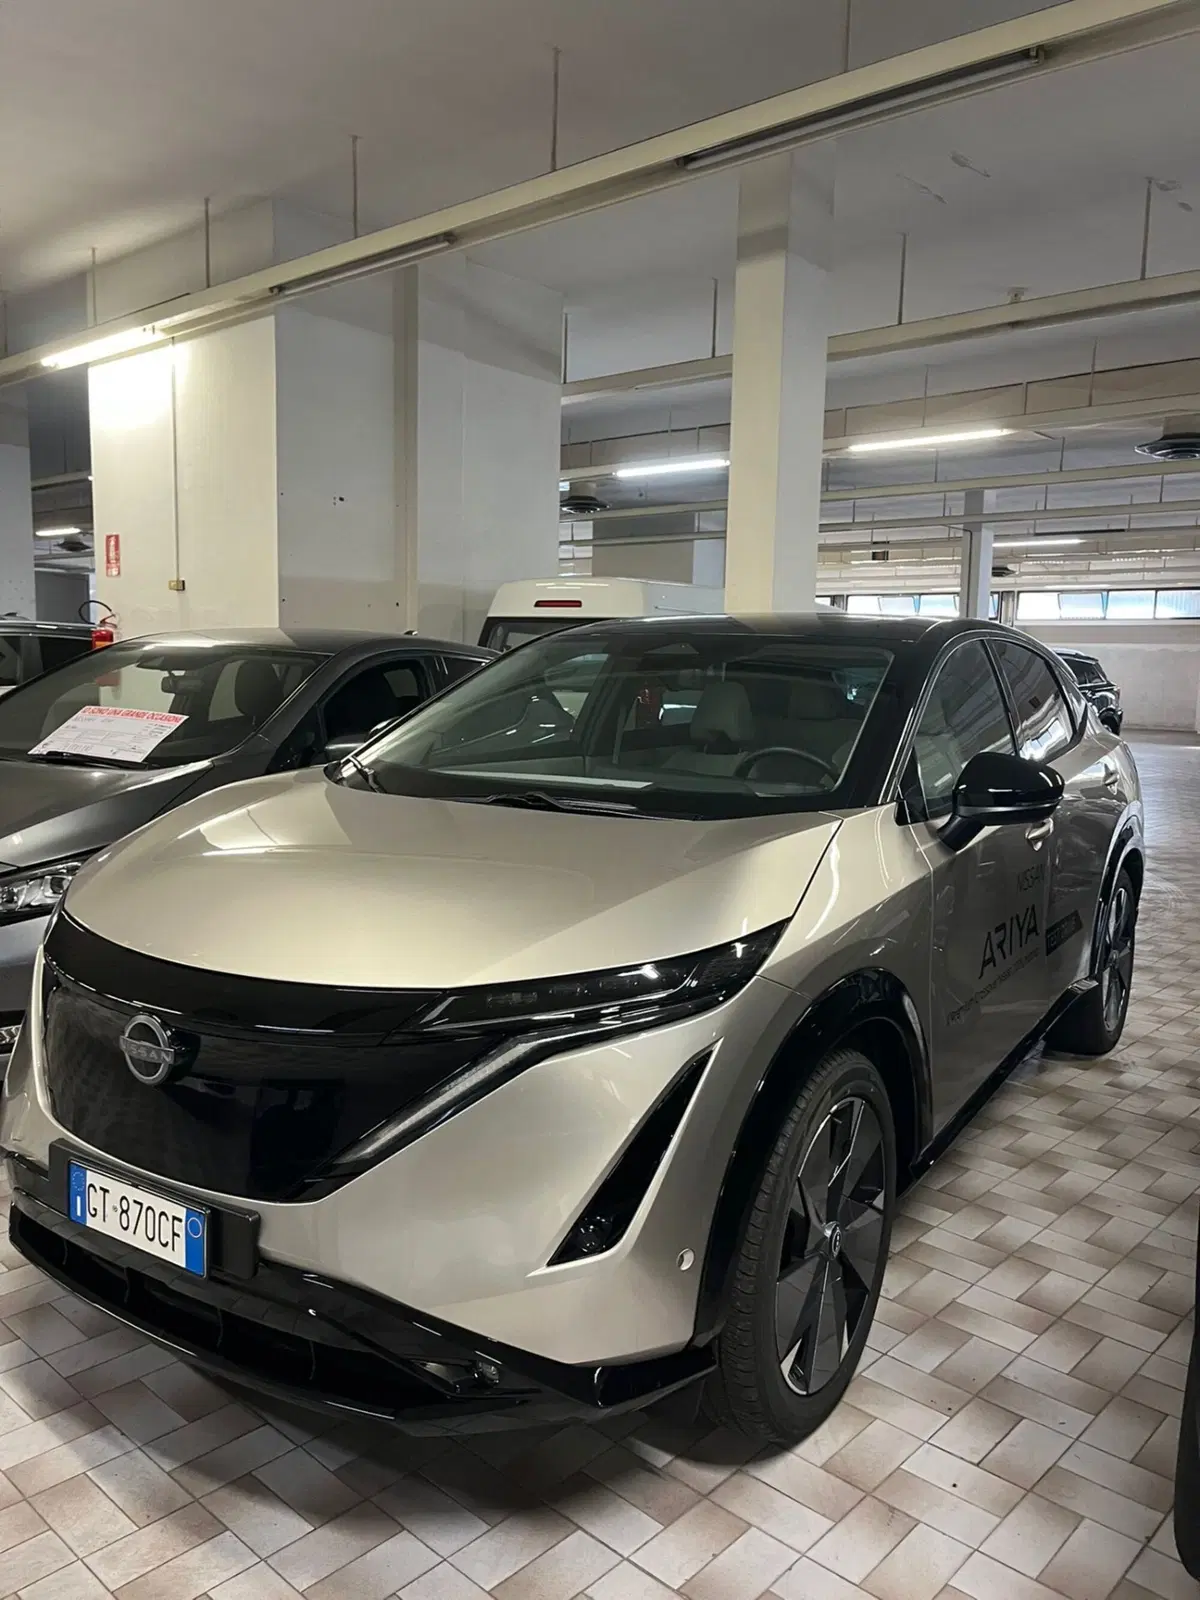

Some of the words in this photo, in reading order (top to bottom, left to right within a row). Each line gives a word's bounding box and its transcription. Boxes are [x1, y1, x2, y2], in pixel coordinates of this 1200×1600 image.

[979, 904, 1040, 980] ARIYA
[121, 1036, 172, 1063] NISSAN
[87, 1183, 110, 1223] GT
[119, 1195, 183, 1252] 870CF
